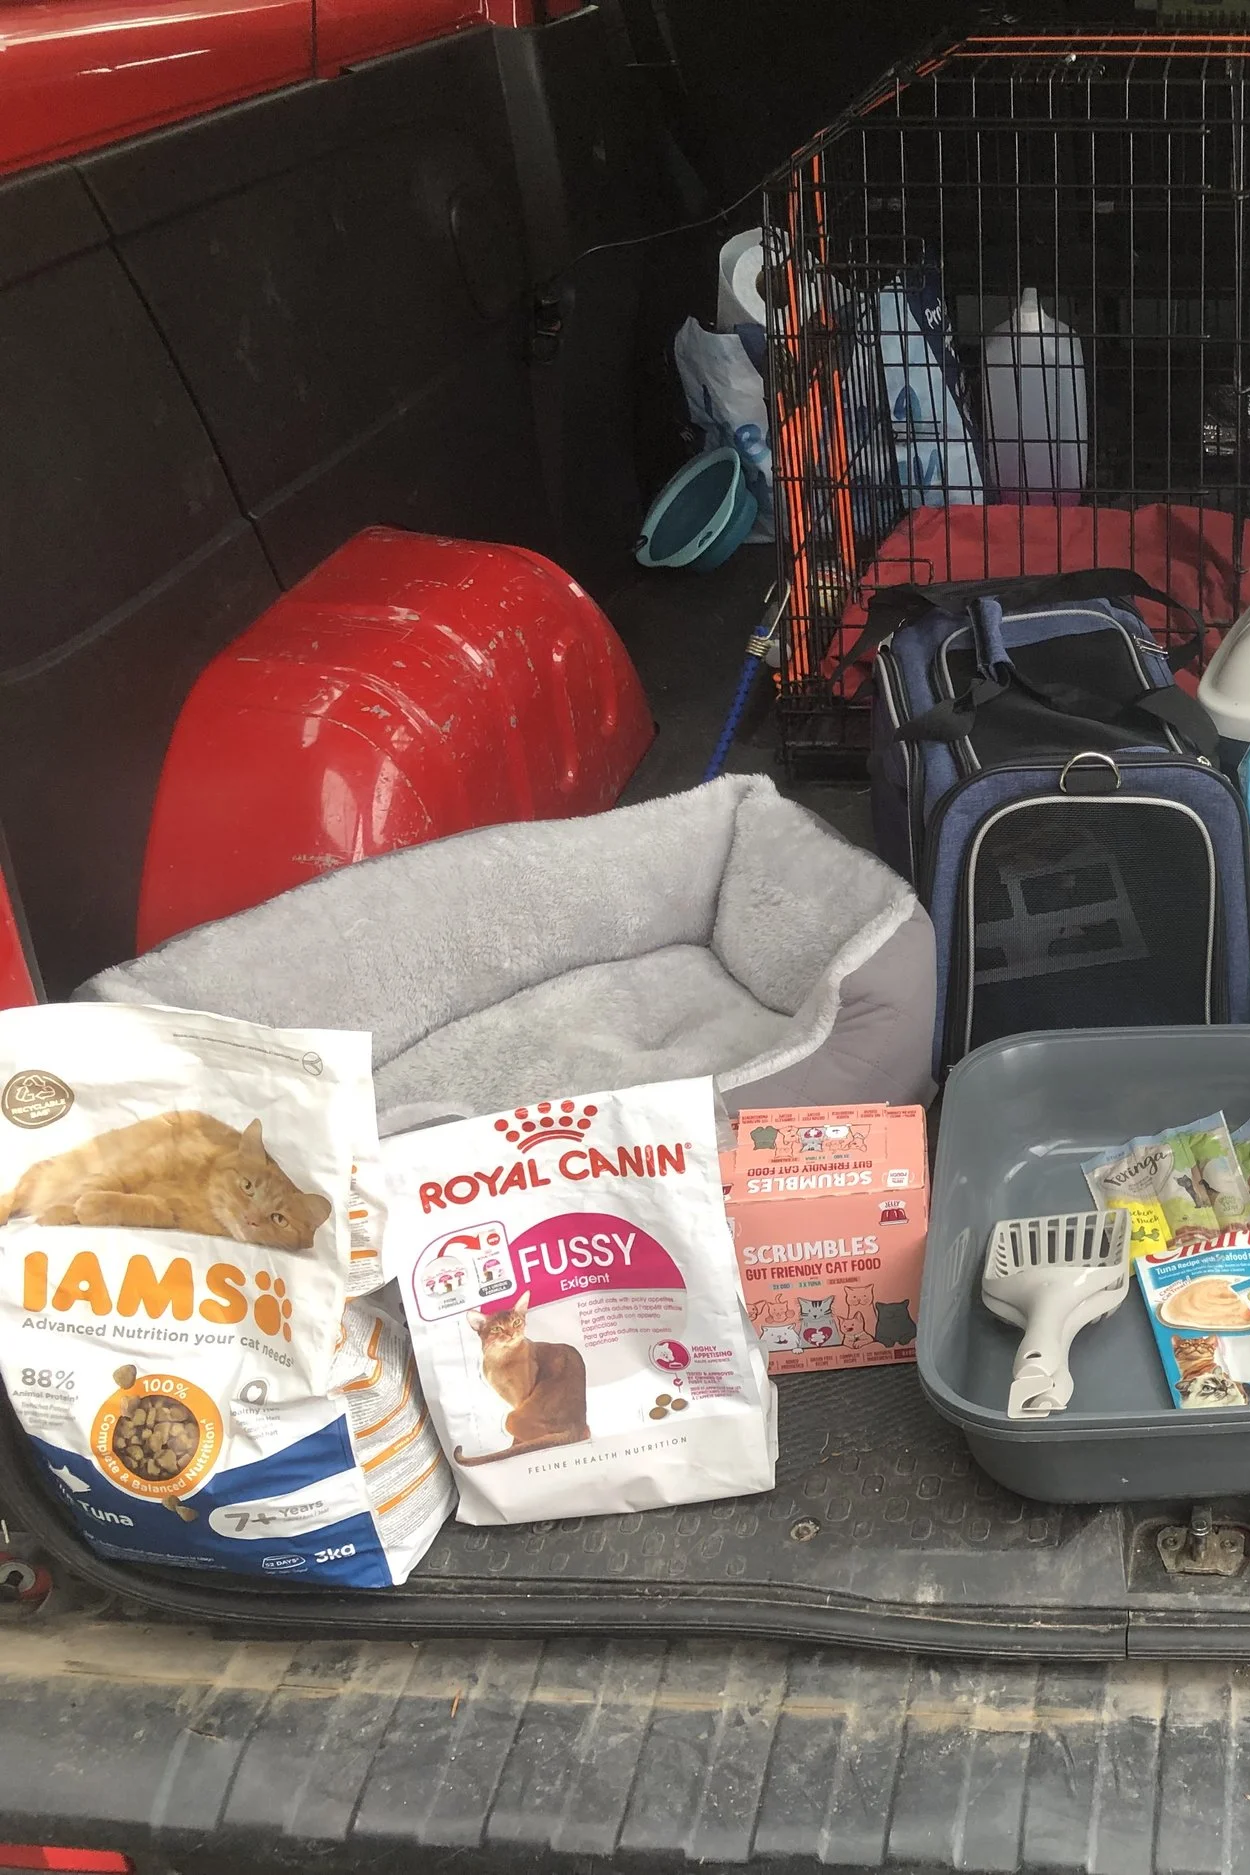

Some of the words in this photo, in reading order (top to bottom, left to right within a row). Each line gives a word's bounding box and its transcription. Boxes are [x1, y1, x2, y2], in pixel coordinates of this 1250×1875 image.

[11, 1098, 66, 1115] RECYCLABLE
[747, 1167, 775, 1176] FOOD
[778, 1165, 799, 1174] CAT
[802, 1163, 850, 1172] FRIENDLY
[852, 1160, 872, 1169] GUT
[1104, 1151, 1168, 1187] Feringa
[419, 1157, 551, 1214] ROYAL
[558, 1142, 686, 1181] CANIN
[747, 1170, 872, 1194] SCRUMBLES
[517, 1232, 637, 1282] FUSSY
[743, 1235, 880, 1265] SCRUMBLES
[745, 1268, 768, 1281] GUT
[771, 1263, 822, 1280] FRIENDLY
[826, 1261, 848, 1274] CAT
[851, 1258, 881, 1271] FOOD
[1156, 1265, 1177, 1275] Tuna
[1178, 1260, 1200, 1269] Recipe
[23, 1251, 248, 1324] IAMS
[559, 1272, 610, 1292] Exigent
[588, 1298, 604, 1306] adult
[22, 1317, 106, 1337] Advanced
[113, 1325, 189, 1343] Nutrition
[194, 1333, 235, 1346] your
[240, 1336, 261, 1351] cat
[21, 1368, 75, 1390] 88%
[142, 1378, 189, 1399] 100%
[12, 1390, 44, 1399] Animal
[232, 1408, 261, 1416] ealthy
[97, 1413, 120, 1474] Complete
[120, 1472, 129, 1484] &
[131, 1479, 186, 1493] Balanced
[527, 1460, 569, 1475] FELINE
[574, 1451, 619, 1466] HEALTH
[625, 1436, 689, 1457] NUTRITION
[79, 1500, 134, 1527] Tuna
[225, 1512, 276, 1532] 7+
[279, 1501, 324, 1518] Years
[314, 1543, 356, 1563] 3kg
